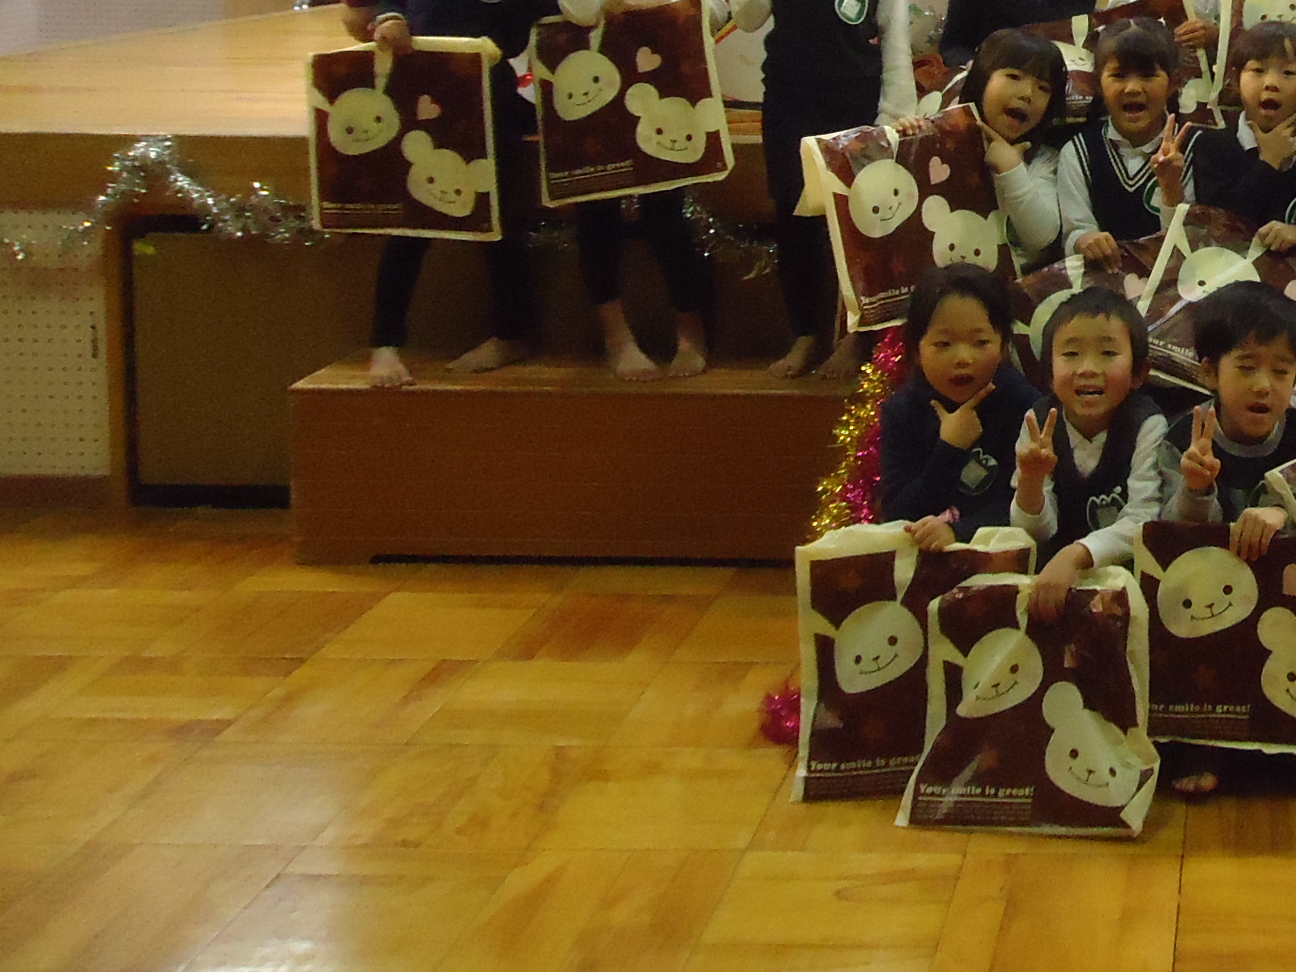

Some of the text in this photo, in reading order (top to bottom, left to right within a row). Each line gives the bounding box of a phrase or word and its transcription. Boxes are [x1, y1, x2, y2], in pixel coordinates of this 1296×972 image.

[1148, 336, 1195, 358] our smile
[1151, 702, 1251, 713] ur smile is great!
[810, 754, 921, 770] Your smile is great
[919, 783, 1035, 797] Your smile is great!
